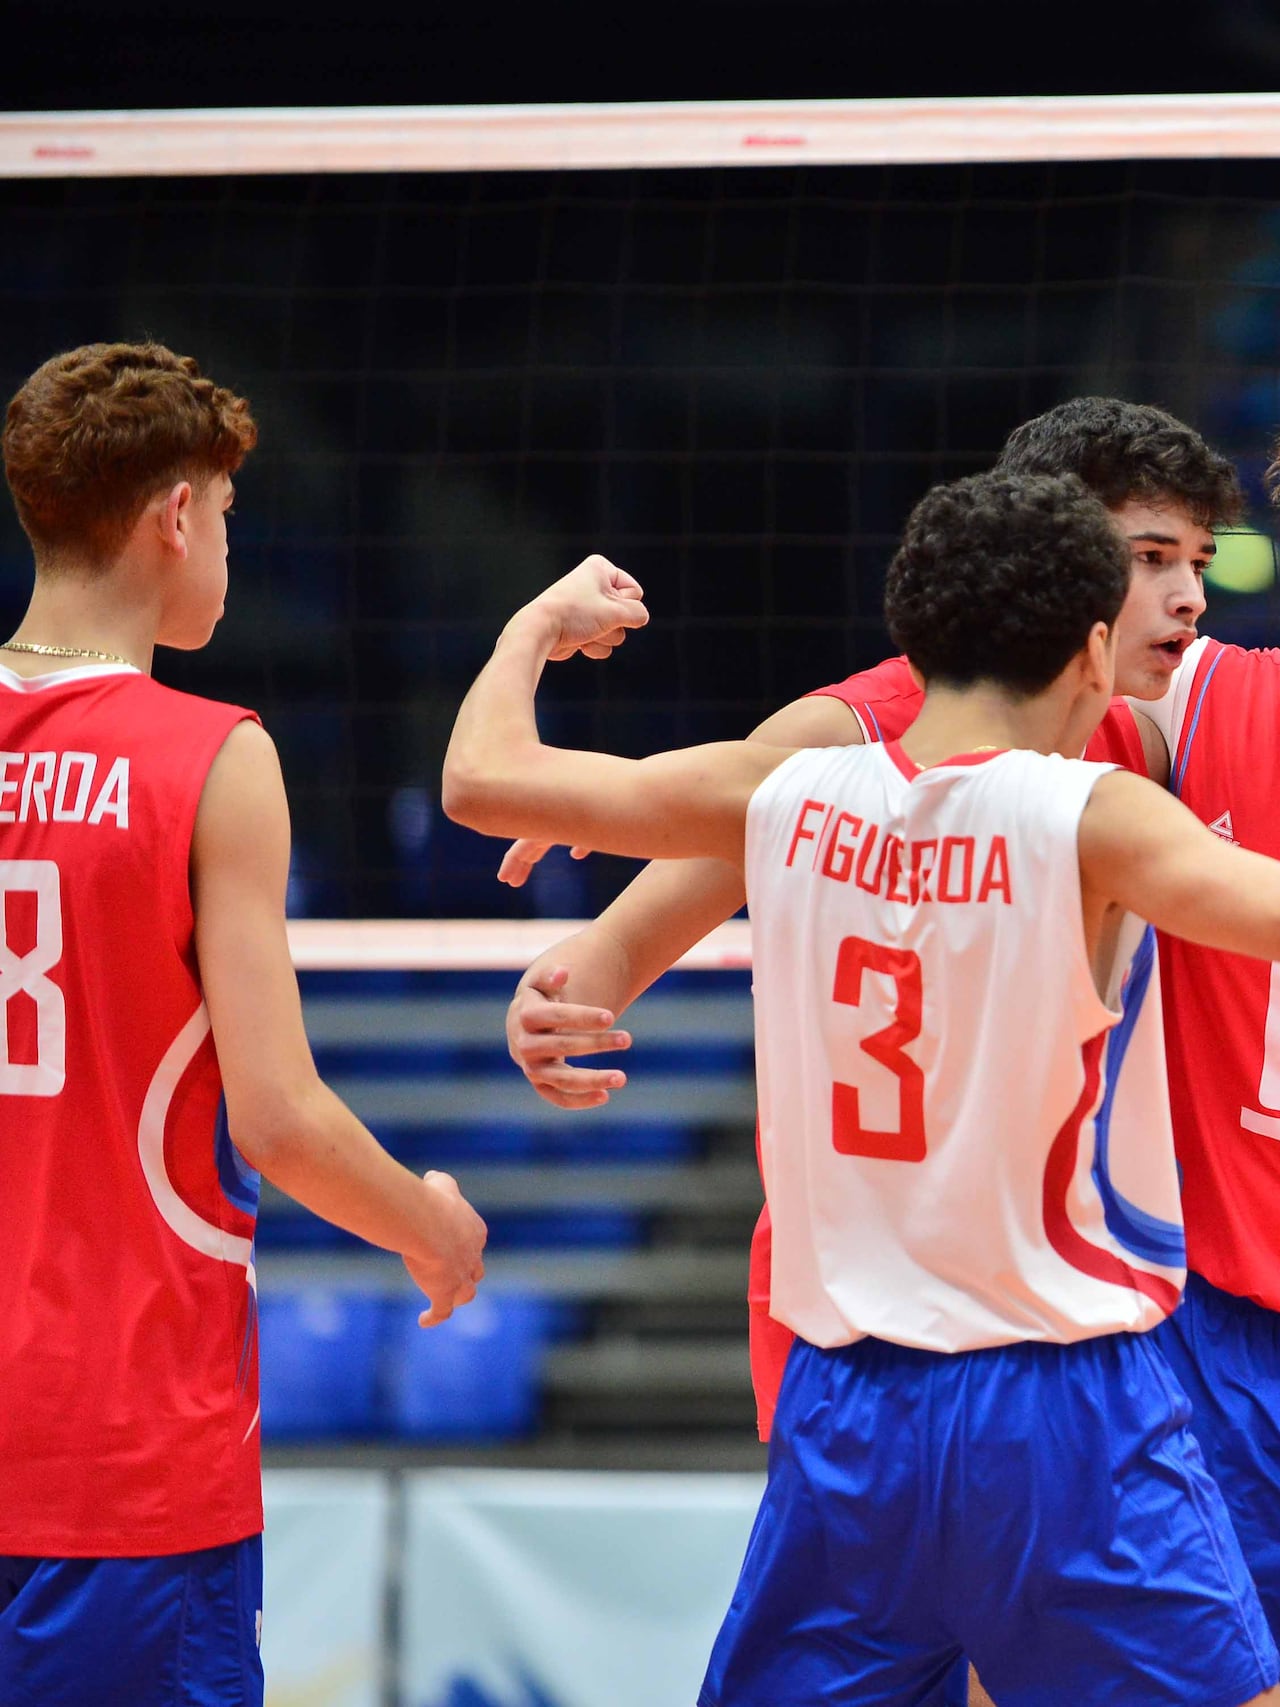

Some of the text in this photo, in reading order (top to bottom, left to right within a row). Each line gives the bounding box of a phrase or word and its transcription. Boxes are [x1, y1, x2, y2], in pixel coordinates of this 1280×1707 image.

[0, 751, 130, 829] EROA
[785, 798, 1012, 905] FIGUEROA
[0, 859, 66, 1096] 8
[832, 936, 927, 1163] 3
